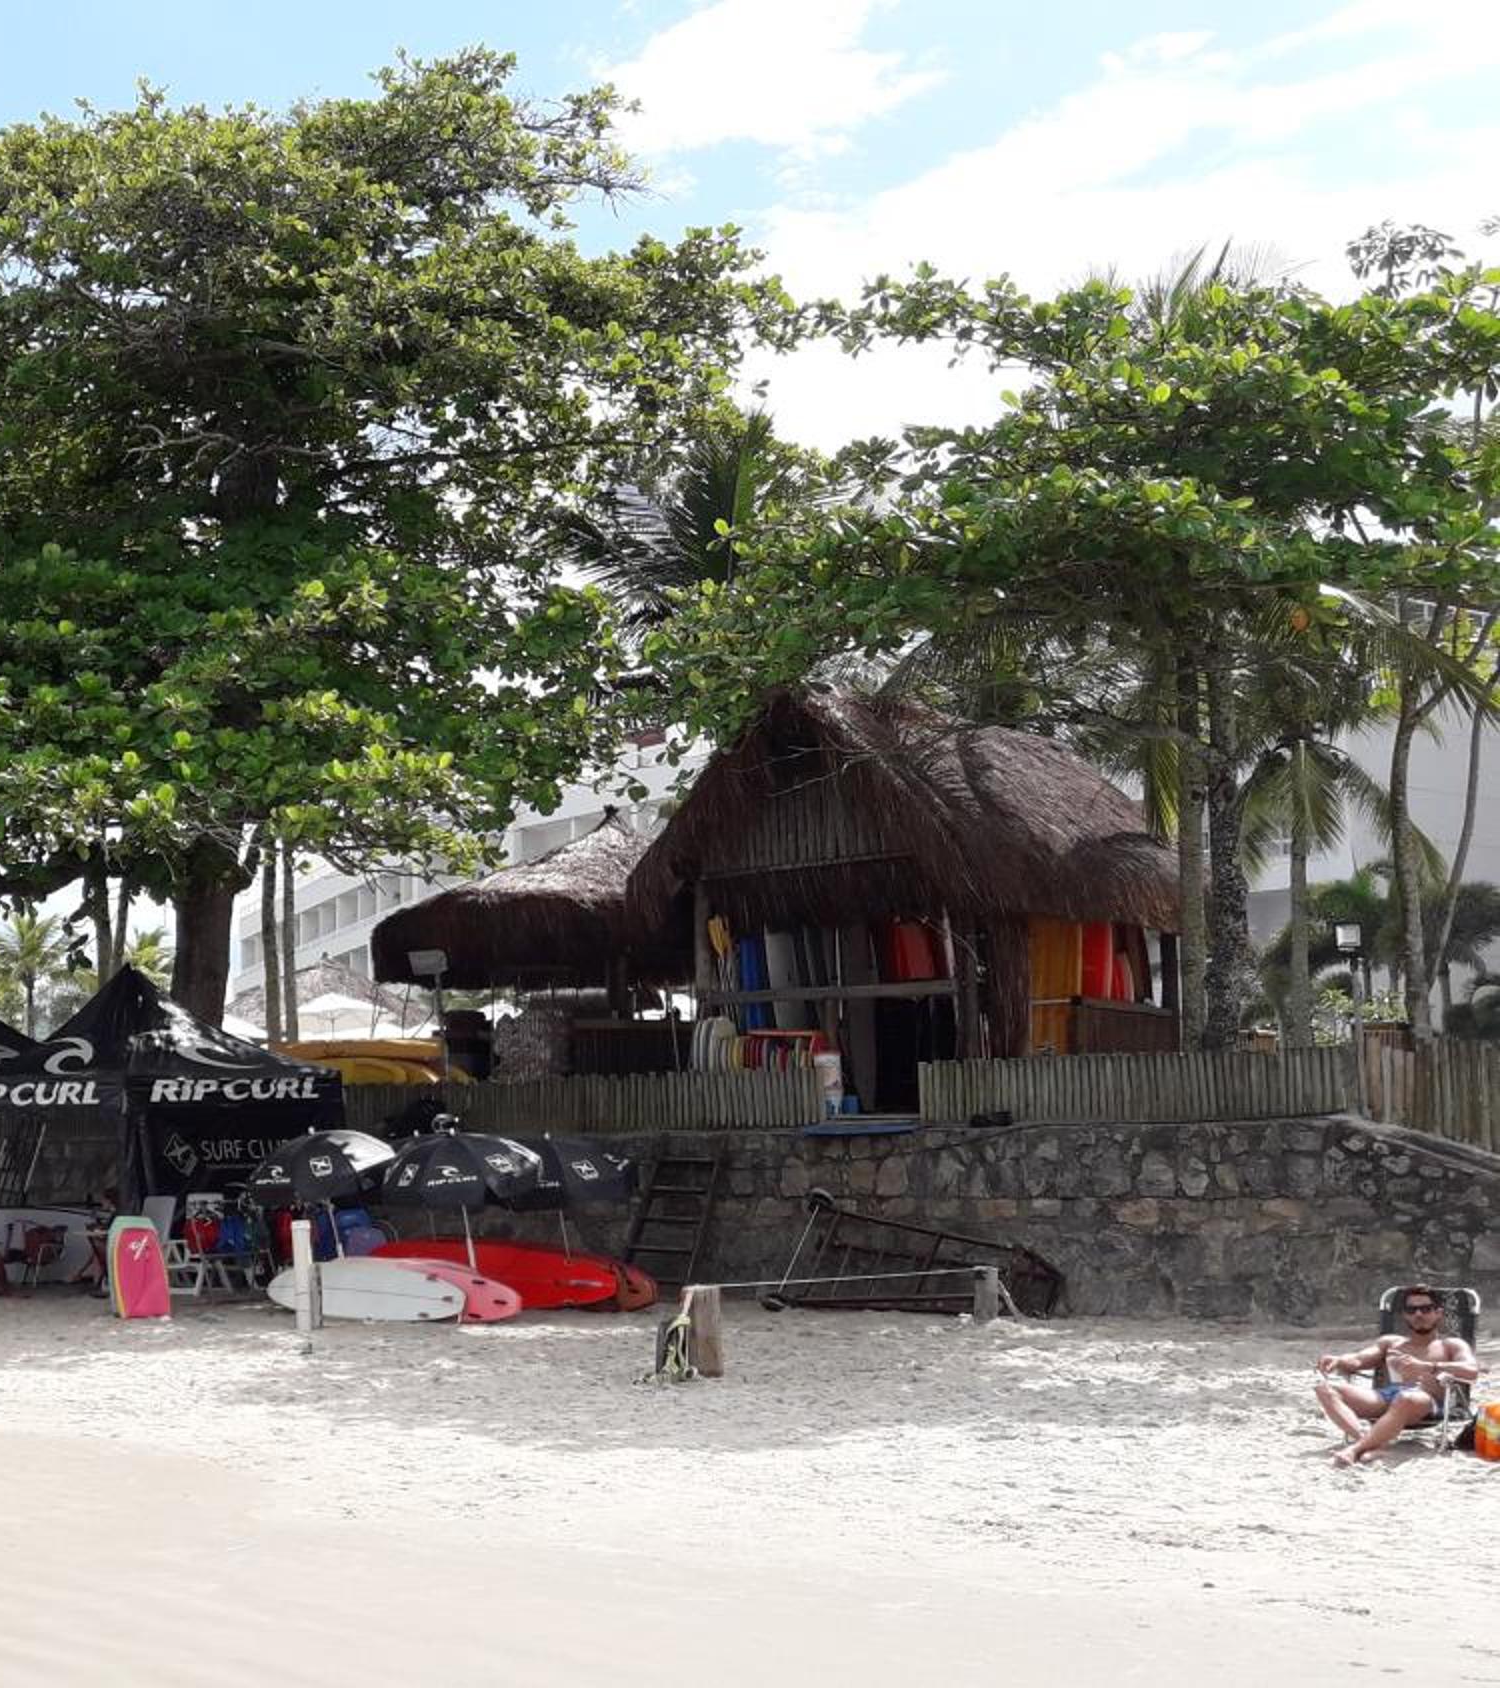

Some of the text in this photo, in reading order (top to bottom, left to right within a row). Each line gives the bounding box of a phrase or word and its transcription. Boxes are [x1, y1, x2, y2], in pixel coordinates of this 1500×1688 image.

[10, 1081, 100, 1106] CURL
[150, 1076, 319, 1103] RIP CURL
[201, 1139, 244, 1160] SURF
